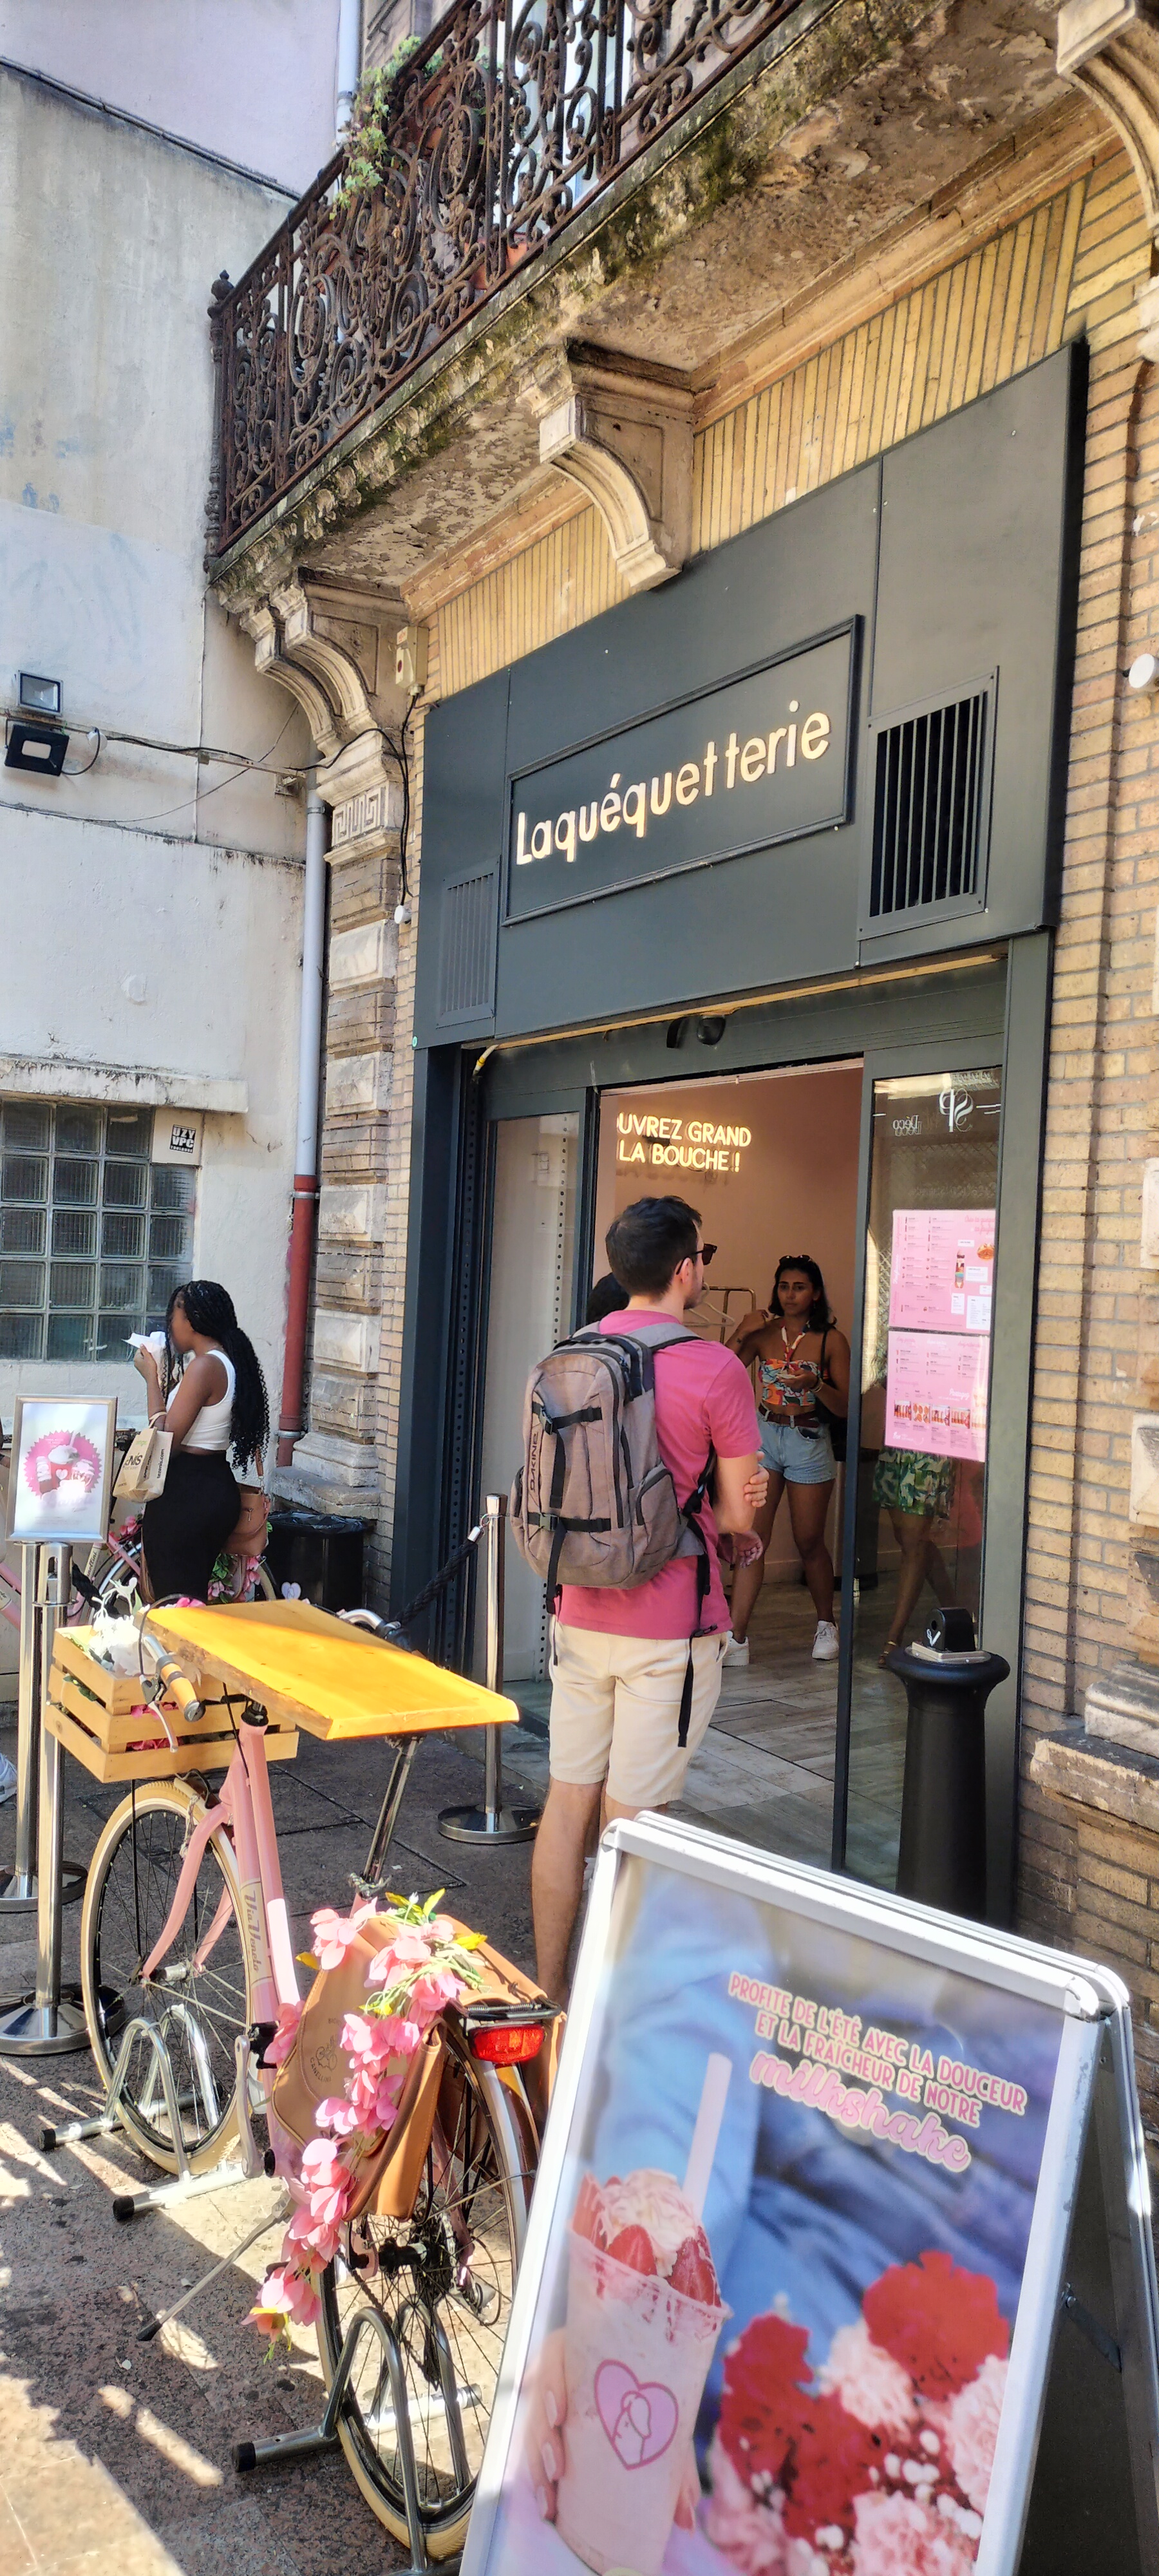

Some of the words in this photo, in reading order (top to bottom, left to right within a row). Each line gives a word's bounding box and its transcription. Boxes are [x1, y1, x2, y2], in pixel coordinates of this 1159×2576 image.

[516, 700, 831, 865] Laquéquetterie
[172, 1136, 194, 1148] VPC
[173, 1127, 196, 1139] UZY
[616, 1112, 683, 1141] UVREZ
[687, 1121, 752, 1148] GRAND
[619, 1140, 646, 1163] LA
[652, 1143, 729, 1171] BOUCHE
[734, 1152, 741, 1173] !
[529, 1431, 539, 1493] DAKINE
[245, 1890, 258, 1923] Via
[248, 1919, 262, 1973] Veneto
[730, 1973, 791, 2016] PROFITE
[794, 2000, 817, 2027] DE
[818, 2009, 862, 2045] L'ÉTÉ
[864, 2030, 907, 2063] AVEC
[911, 2047, 932, 2075] LA
[939, 2058, 1026, 2113] DOUCEUR
[757, 2012, 777, 2038] ET
[779, 2022, 799, 2049] LA
[804, 2033, 893, 2088] FRAÎCHEUR
[898, 2071, 921, 2099] DE
[926, 2083, 981, 2125] NOTRE
[750, 2052, 970, 2171] milkshake
